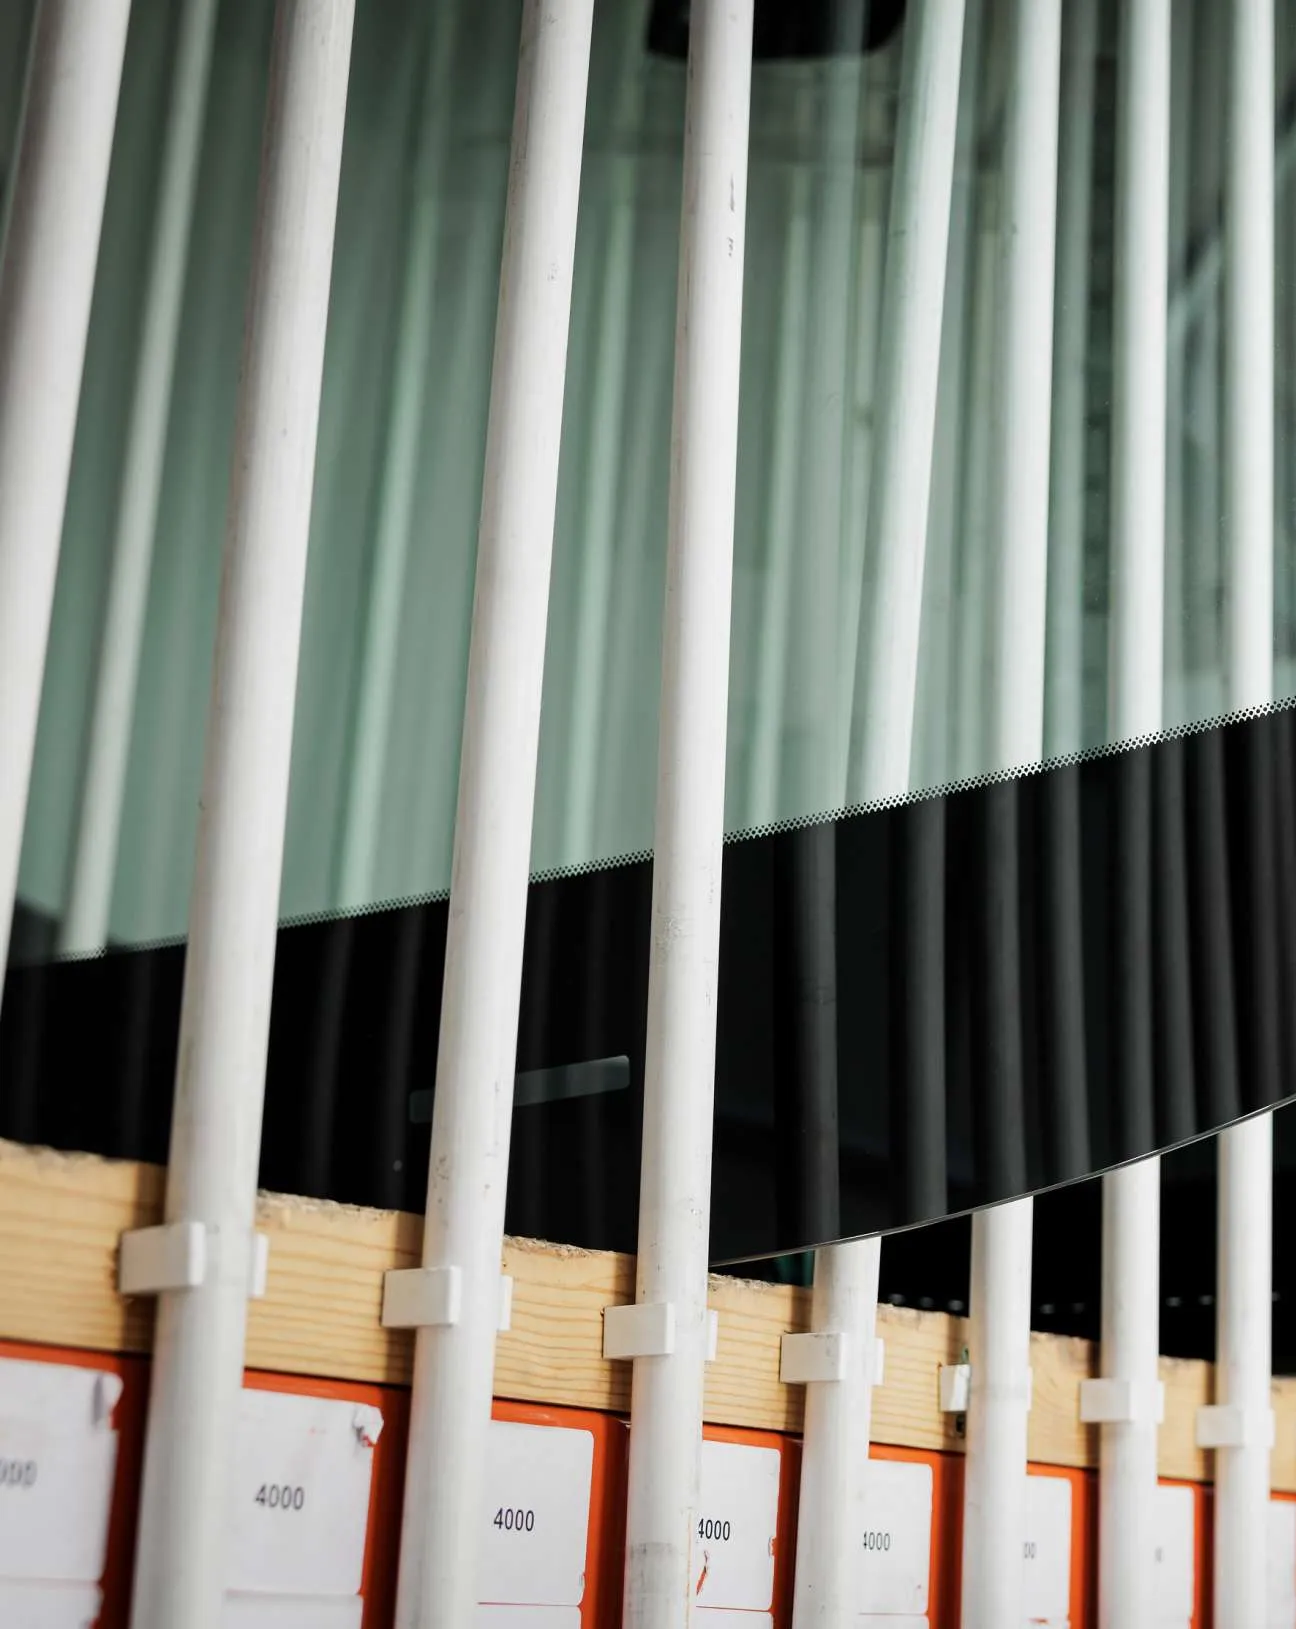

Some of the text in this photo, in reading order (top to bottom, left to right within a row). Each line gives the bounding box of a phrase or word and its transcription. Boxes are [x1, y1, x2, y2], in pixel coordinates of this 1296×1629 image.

[255, 1484, 304, 1511] 4000
[493, 1508, 535, 1533] 4000
[698, 1518, 731, 1541] 4000
